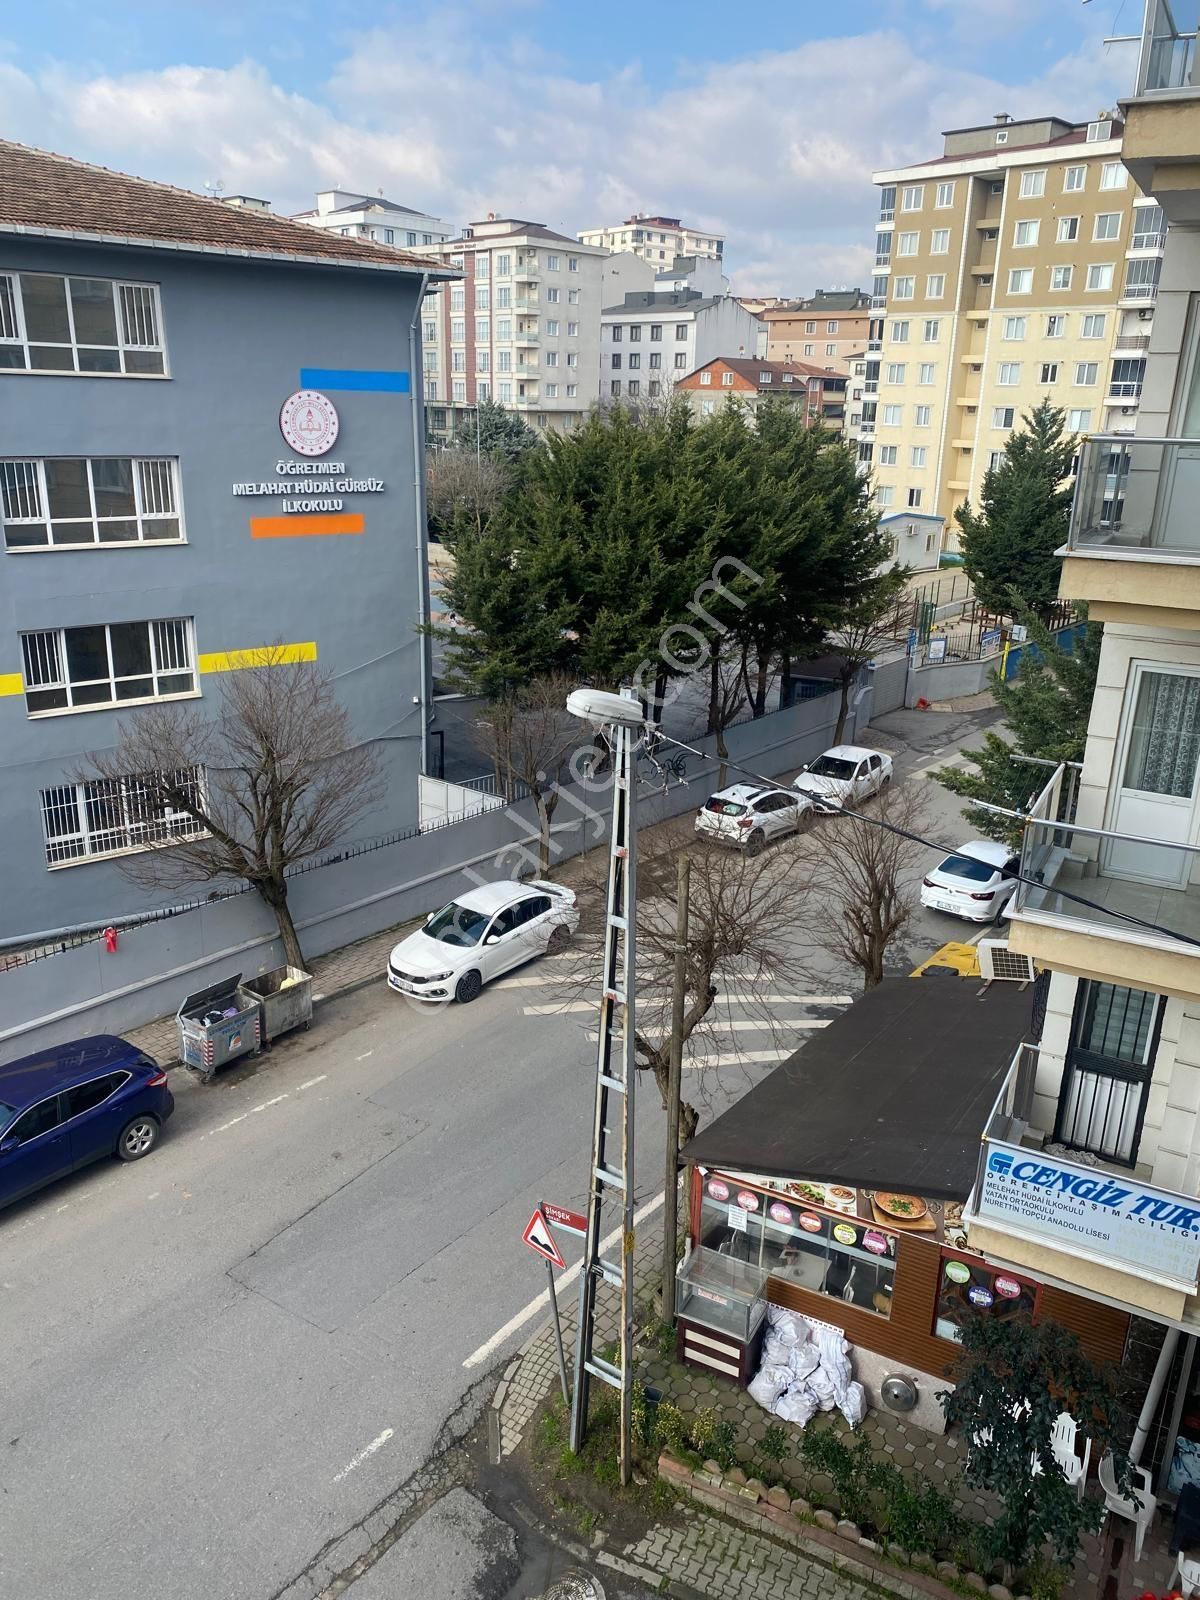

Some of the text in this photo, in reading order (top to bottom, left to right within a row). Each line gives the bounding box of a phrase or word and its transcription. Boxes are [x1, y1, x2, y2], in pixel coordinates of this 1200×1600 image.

[276, 460, 345, 475] ÖĞRETMEN
[232, 482, 292, 495] MELAHAT
[336, 477, 385, 493] GÜRBÜZ
[282, 499, 343, 513] İLKOKULU
[1011, 1161, 1134, 1208] CENGİZ
[985, 1189, 1055, 1215] VATAN ORTAOKULU
[986, 1181, 1020, 1196] MELEHAT
[1045, 1198, 1084, 1216] İLKOKULU
[984, 1197, 1110, 1241] NURETTİN TOPÇU ANADOLU LİSESİ
